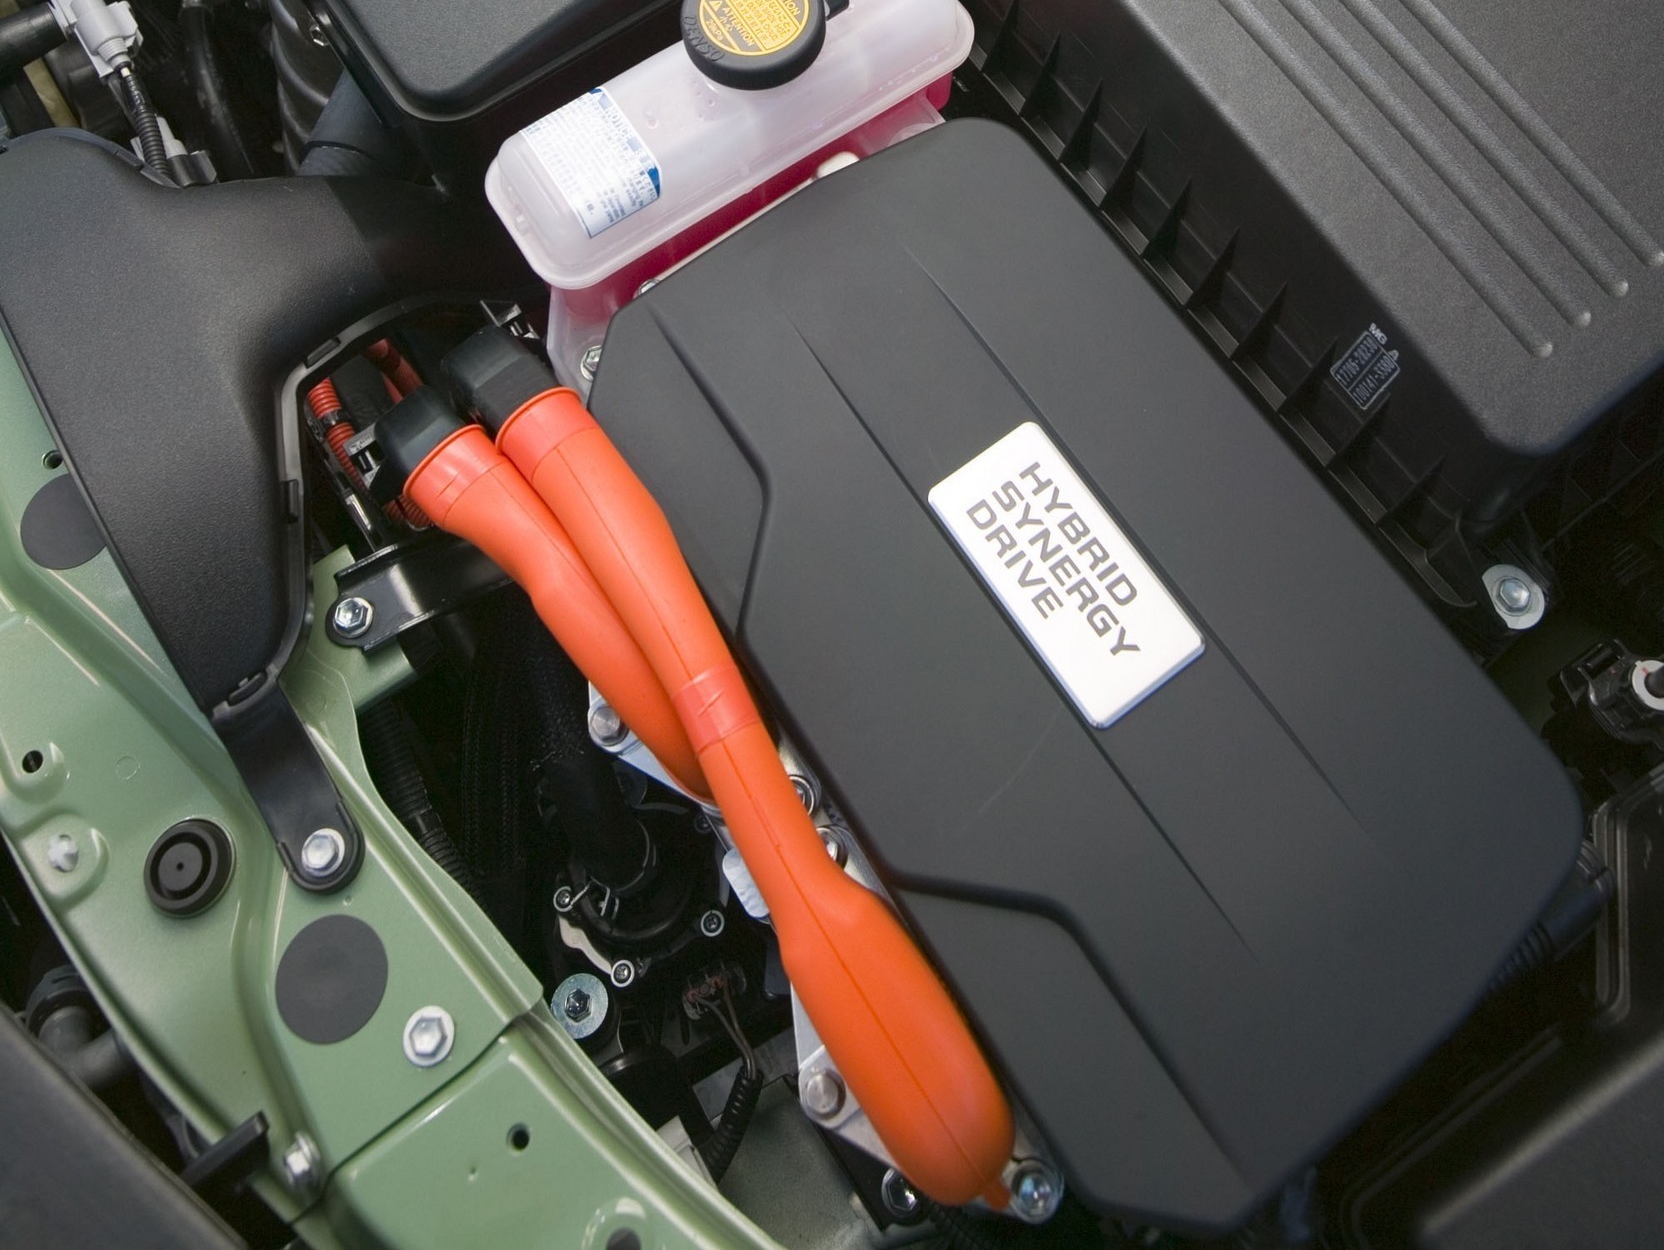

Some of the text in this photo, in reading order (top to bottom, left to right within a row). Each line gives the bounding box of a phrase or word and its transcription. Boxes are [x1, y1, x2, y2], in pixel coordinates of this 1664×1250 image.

[683, 15, 725, 62] DENSO
[721, 6, 755, 46] ATTENTION
[606, 105, 631, 138] NOTICE
[966, 499, 1064, 620] DRIVE
[991, 480, 1141, 656] SYNERGY
[1018, 461, 1138, 606] HYBRID
